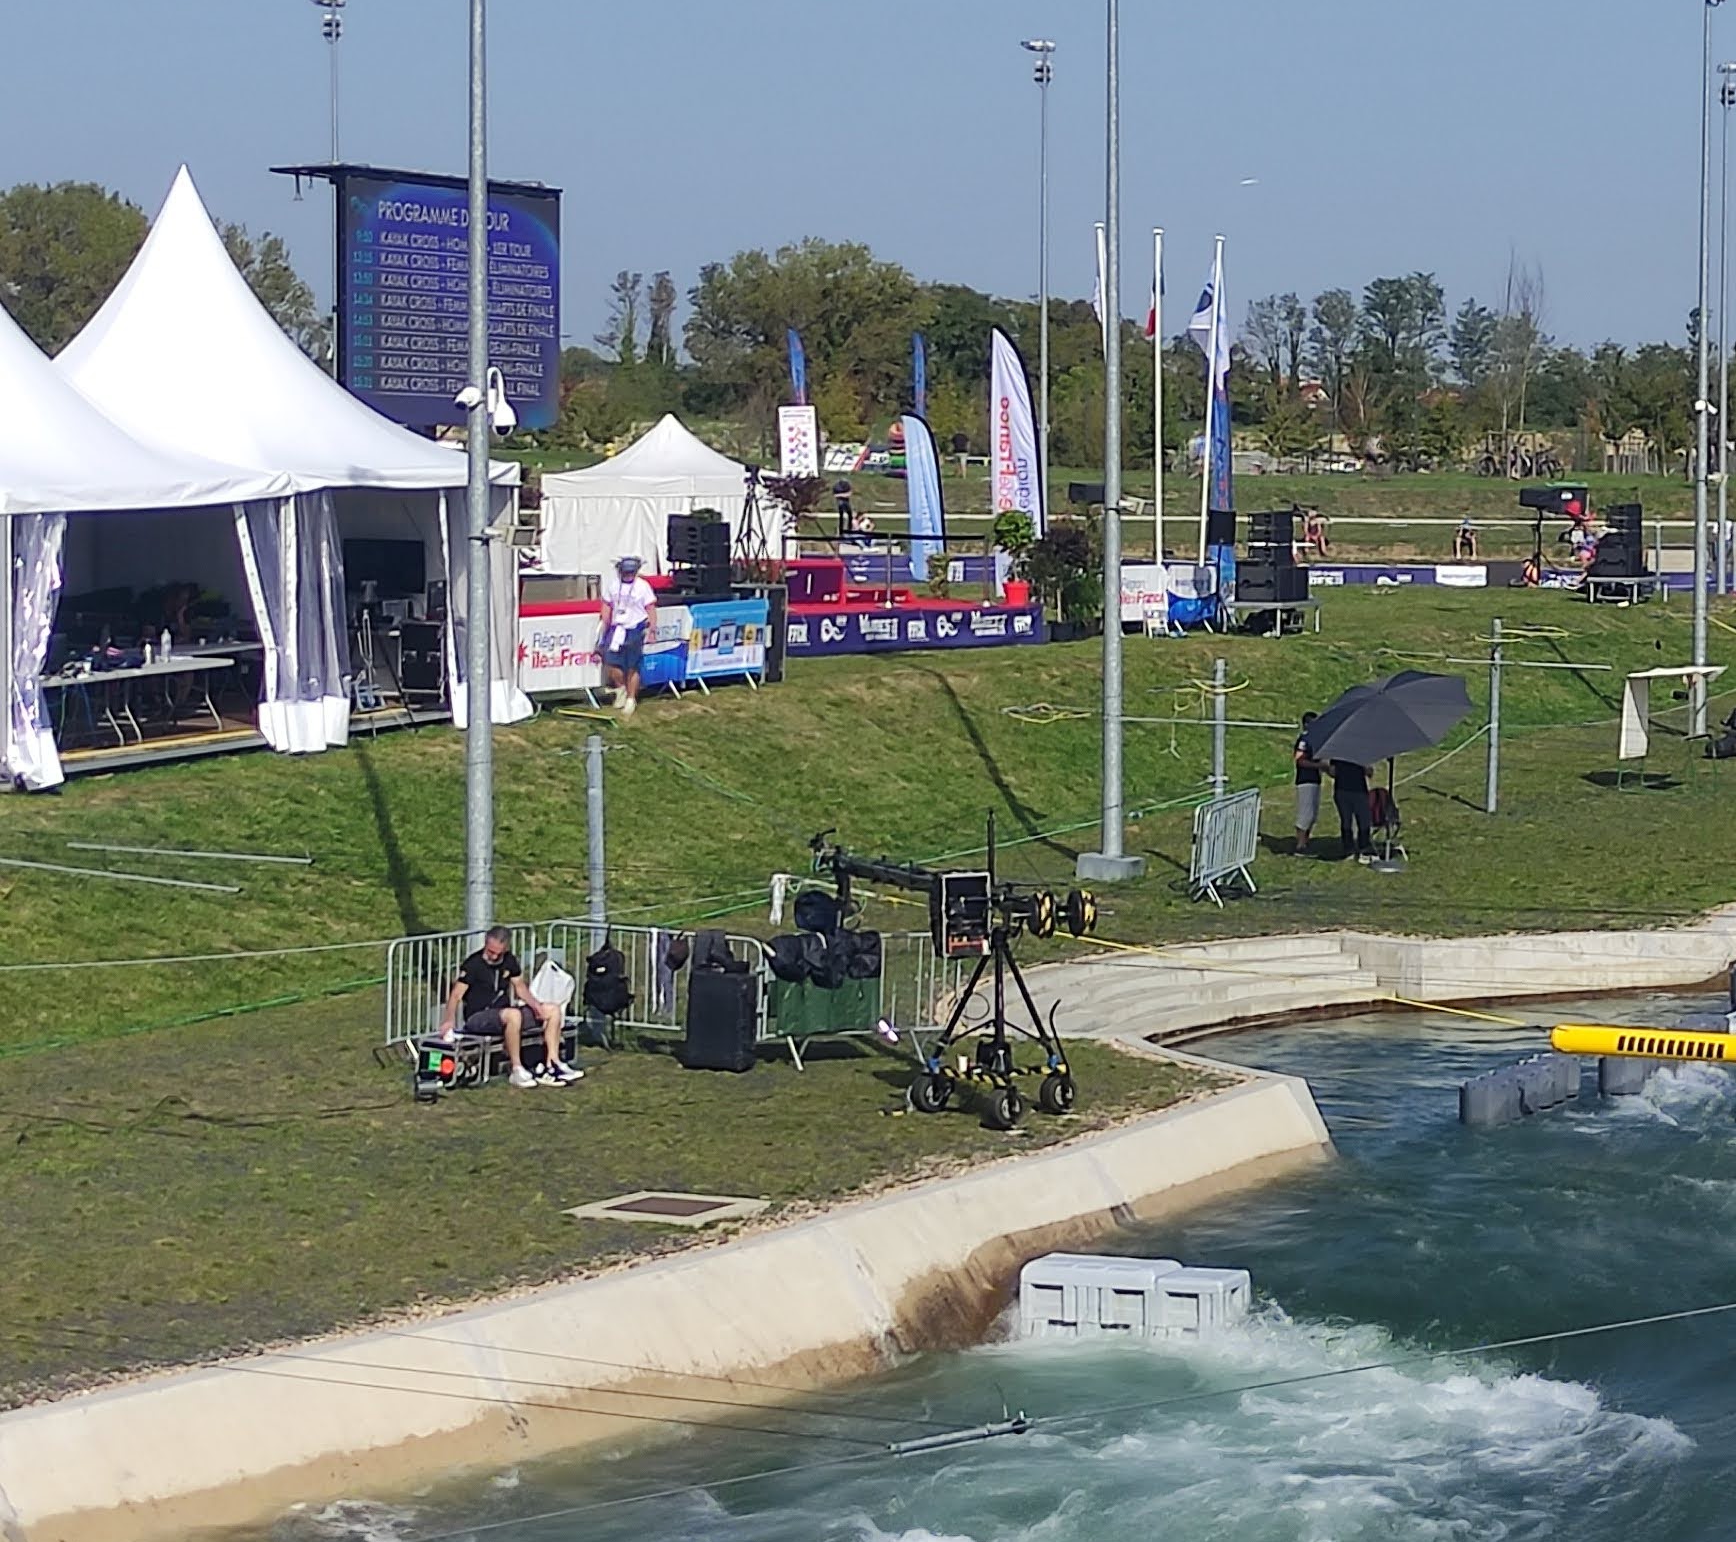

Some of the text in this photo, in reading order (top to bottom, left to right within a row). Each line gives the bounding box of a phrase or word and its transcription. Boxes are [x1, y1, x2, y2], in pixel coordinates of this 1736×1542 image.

[379, 200, 510, 232] PROGRAMME D OUR
[533, 631, 574, 651] Région
